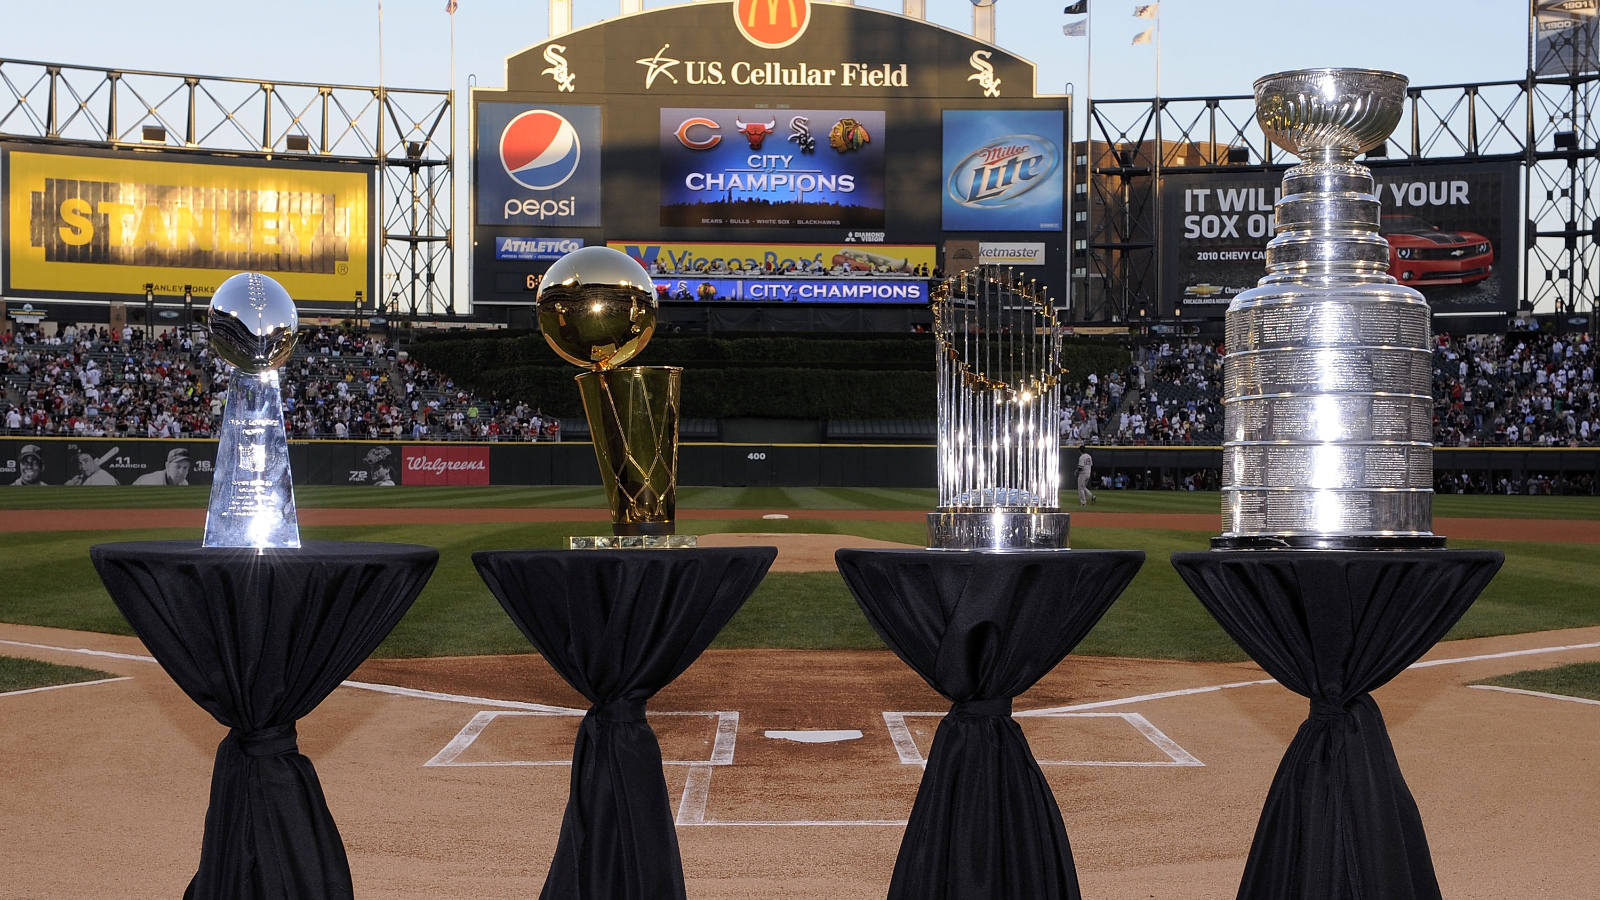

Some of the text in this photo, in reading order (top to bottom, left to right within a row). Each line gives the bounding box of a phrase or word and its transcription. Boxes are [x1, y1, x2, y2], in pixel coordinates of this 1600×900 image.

[1545, 20, 1572, 29] 1900
[684, 61, 909, 87] U.S. Cellular Field
[747, 154, 793, 168] CITY
[977, 145, 1030, 162] Miller
[685, 172, 855, 193] CHAMPIONS
[966, 154, 1043, 203] Lite
[1185, 189, 1211, 212] IT
[1389, 180, 1470, 207] YOUR
[504, 196, 575, 220] pepsi
[58, 198, 324, 254] STANLEY
[1184, 214, 1240, 239] SOX
[860, 232, 884, 242] VISION
[1197, 251, 1218, 260] 2010
[1220, 251, 1250, 260] CHEVY
[750, 284, 792, 298] CITY
[799, 284, 921, 299] CHAMPIONS
[115, 456, 131, 464] 11
[747, 452, 766, 460] 400
[7, 460, 16, 468] 9
[195, 460, 211, 468] 16
[406, 456, 486, 475] Walgreens
[349, 470, 367, 479] 72
